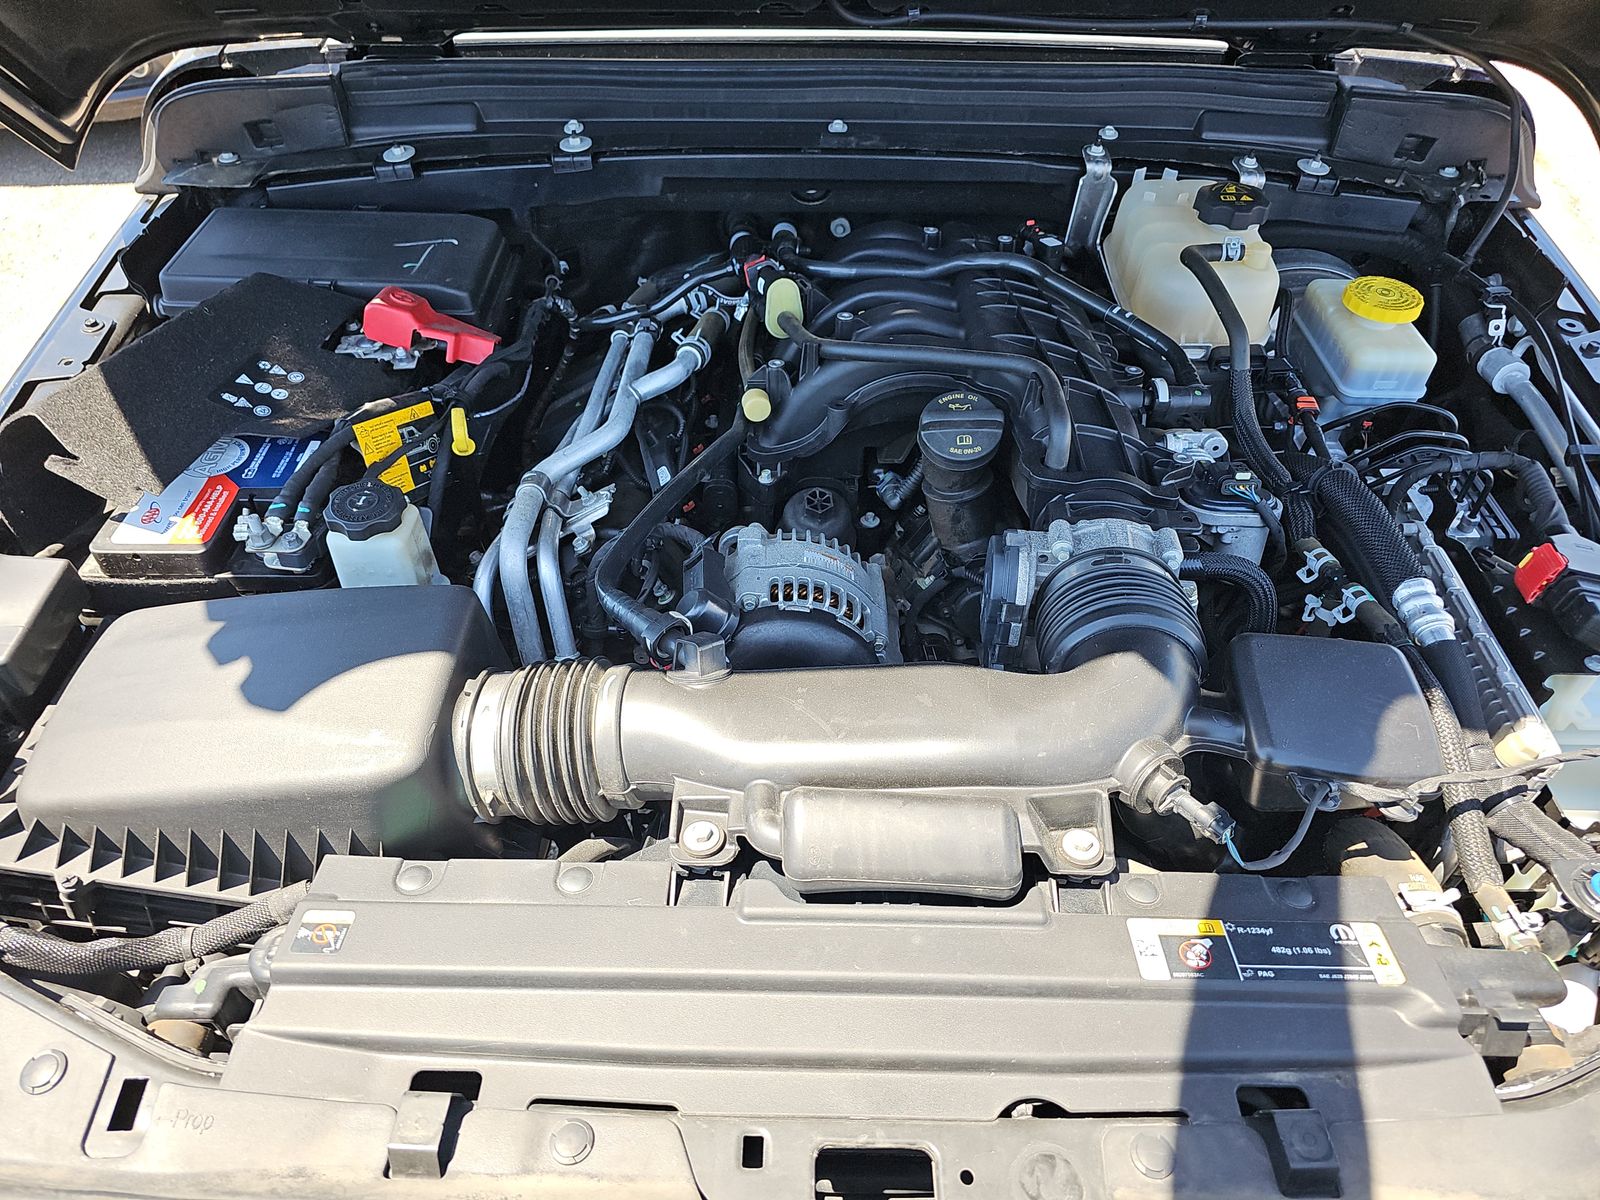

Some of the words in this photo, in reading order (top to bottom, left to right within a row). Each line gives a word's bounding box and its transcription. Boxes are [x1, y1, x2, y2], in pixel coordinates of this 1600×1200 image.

[938, 393, 965, 404] ENGINE
[967, 394, 979, 402] OIL
[949, 447, 963, 455] SAE
[963, 445, 982, 455] 0W-20
[1237, 927, 1274, 936] R-1234yf
[1314, 947, 1332, 956] lbs)
[1257, 970, 1275, 978] PAG
[172, 1108, 215, 1135] Prop
